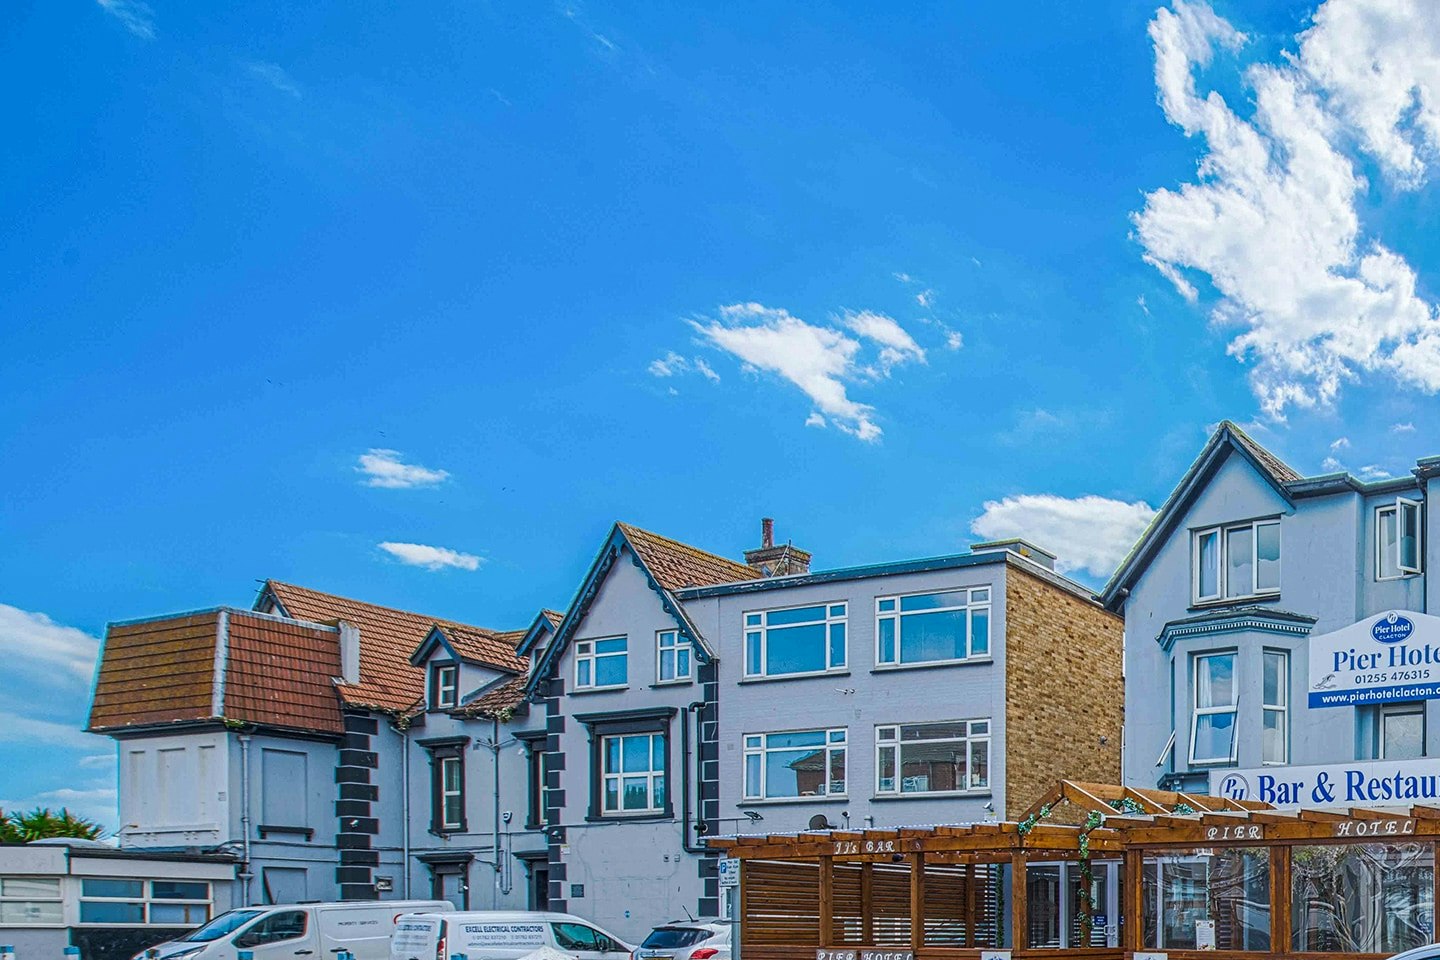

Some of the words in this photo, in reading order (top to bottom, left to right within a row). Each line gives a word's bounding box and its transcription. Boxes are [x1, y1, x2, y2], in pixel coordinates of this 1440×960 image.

[1374, 625, 1390, 634] Pier
[1390, 624, 1411, 634] Hotel
[1332, 648, 1382, 672] Pier
[1355, 673, 1387, 684] 01255
[1390, 669, 1430, 681] 476315
[1257, 775, 1304, 804] Bar
[1312, 771, 1336, 803] &
[1207, 825, 1260, 840] PIER
[1337, 820, 1413, 836] HOTEL
[866, 840, 895, 853] BAR
